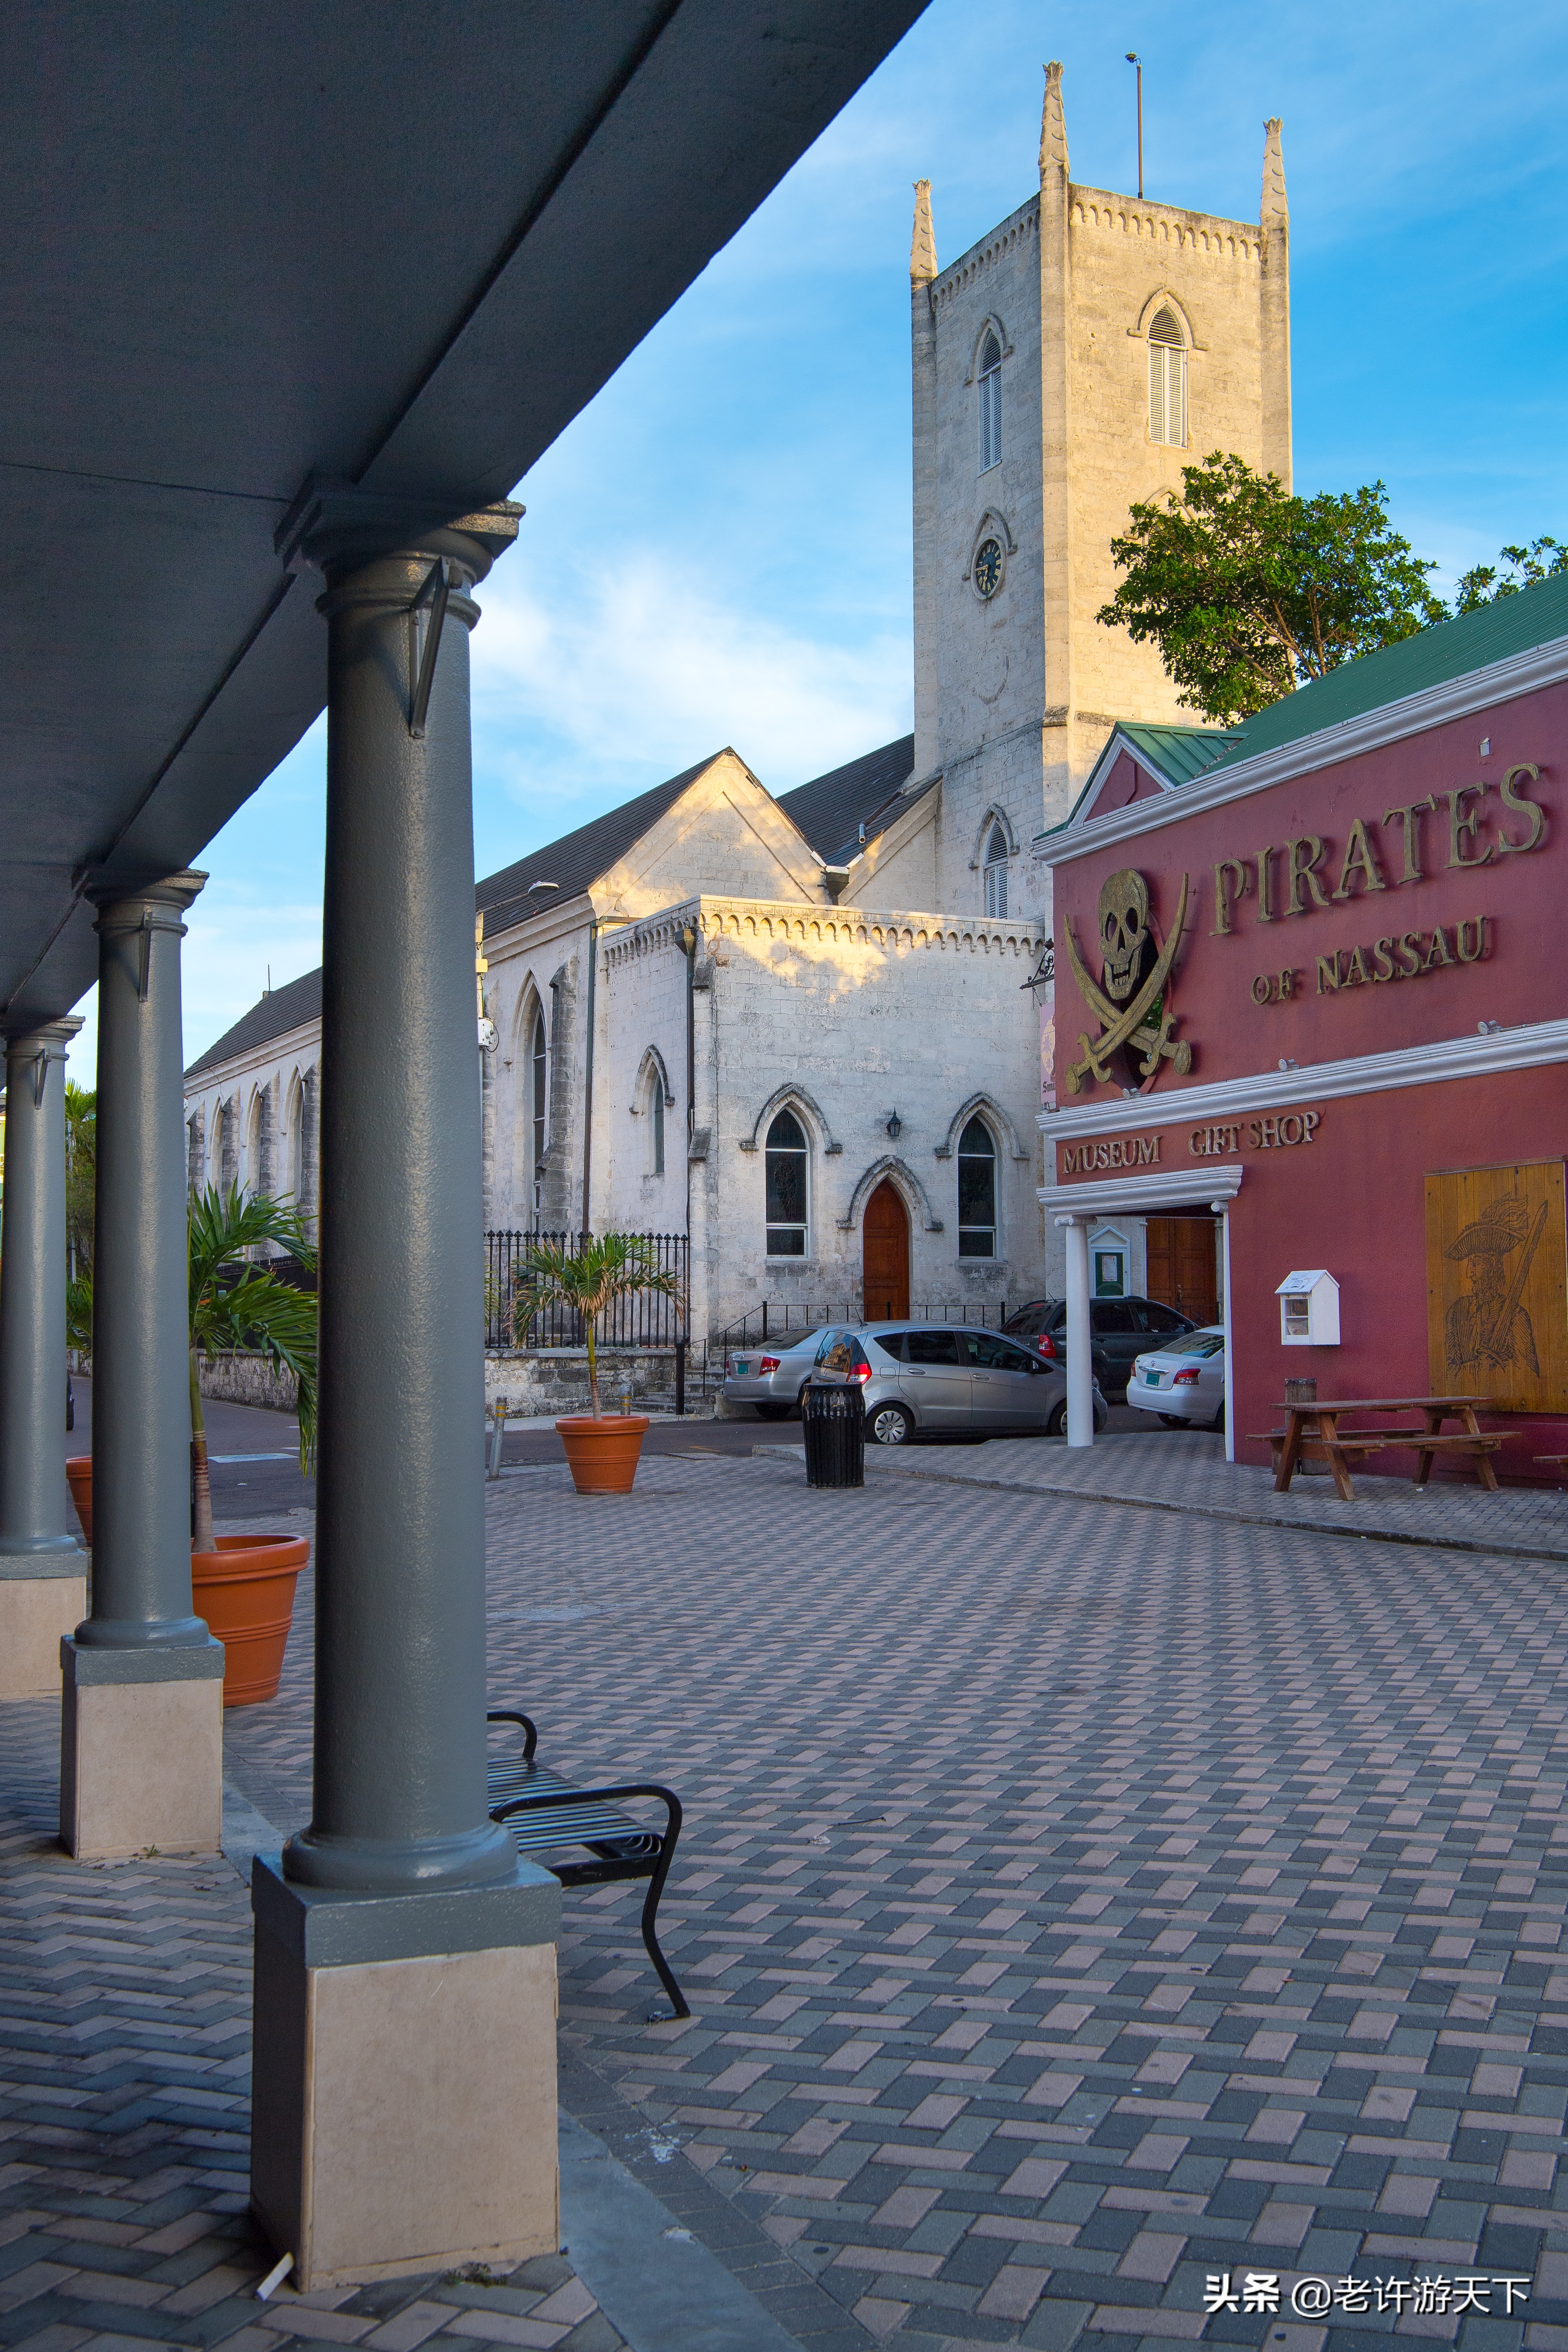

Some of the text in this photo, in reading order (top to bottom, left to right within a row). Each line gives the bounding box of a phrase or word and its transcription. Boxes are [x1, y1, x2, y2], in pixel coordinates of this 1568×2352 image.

[1209, 763, 1545, 936] PIRATES
[1250, 915, 1487, 1005] OF NASSAU
[1061, 1111, 1319, 1174] MUSEUM GIFT SHOP
